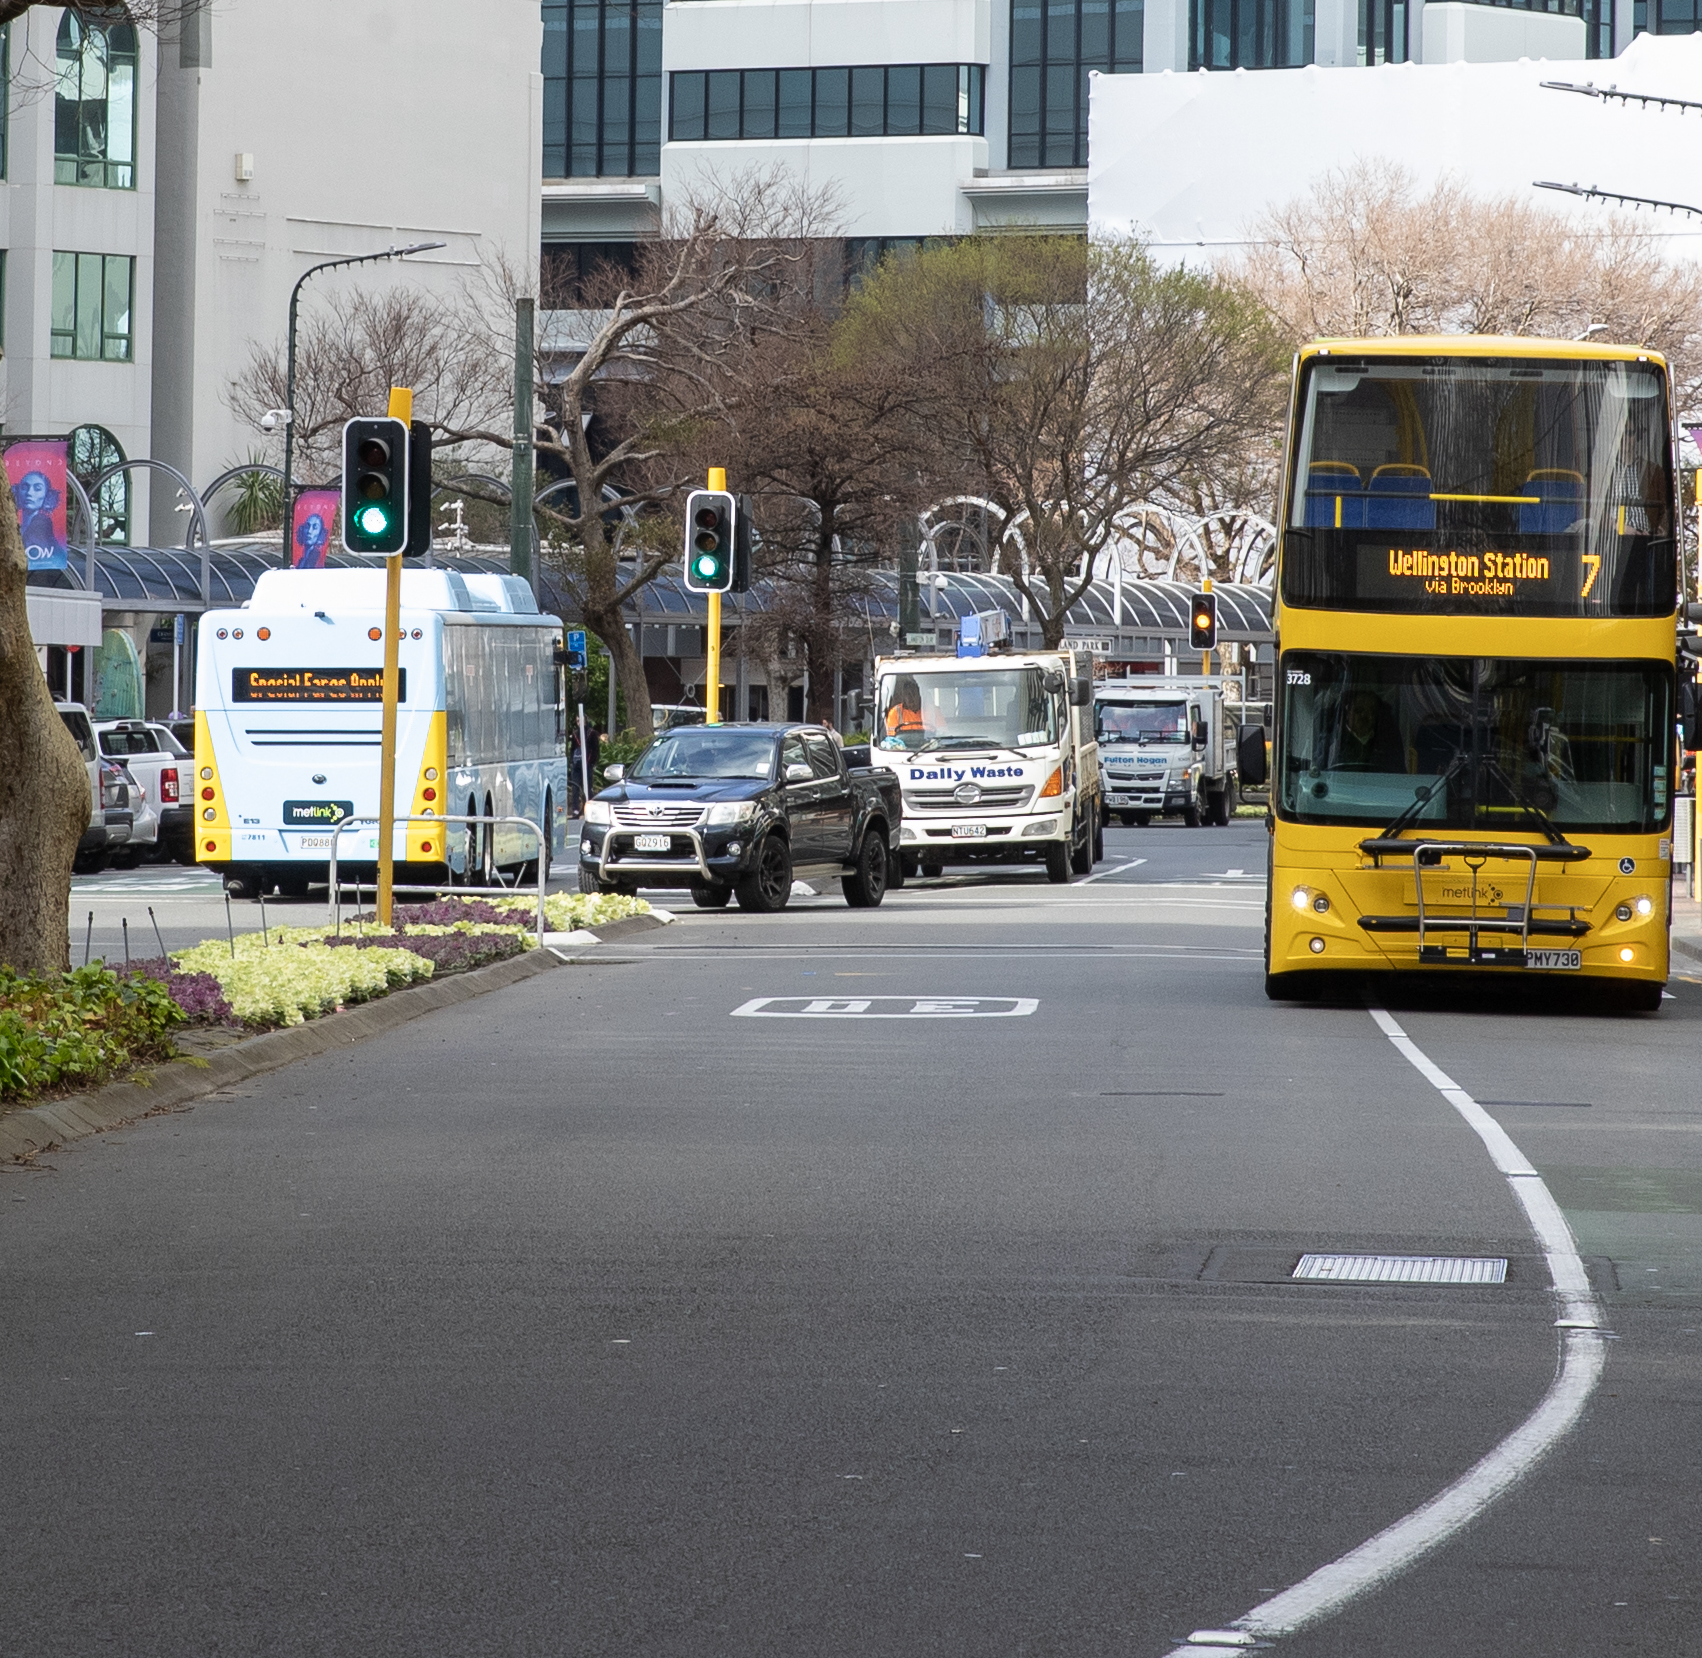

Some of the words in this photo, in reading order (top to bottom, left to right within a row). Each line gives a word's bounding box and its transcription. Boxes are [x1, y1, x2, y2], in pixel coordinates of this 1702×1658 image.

[1389, 549, 1480, 576] Wellington
[1484, 552, 1549, 579] Station
[1581, 554, 1600, 597] 7
[1425, 576, 1447, 593] via
[1451, 577, 1514, 595] Brooklyn
[1082, 641, 1099, 651] PARK
[1286, 674, 1311, 685] 3728
[1104, 755, 1135, 764] Fulton
[1136, 756, 1168, 765] Hogan
[970, 766, 1024, 779] Waste
[292, 806, 332, 818] metlink
[247, 833, 266, 841] 7811
[953, 825, 985, 837] NTU642
[1442, 886, 1488, 899] metlink
[1528, 952, 1580, 967] PMY730
